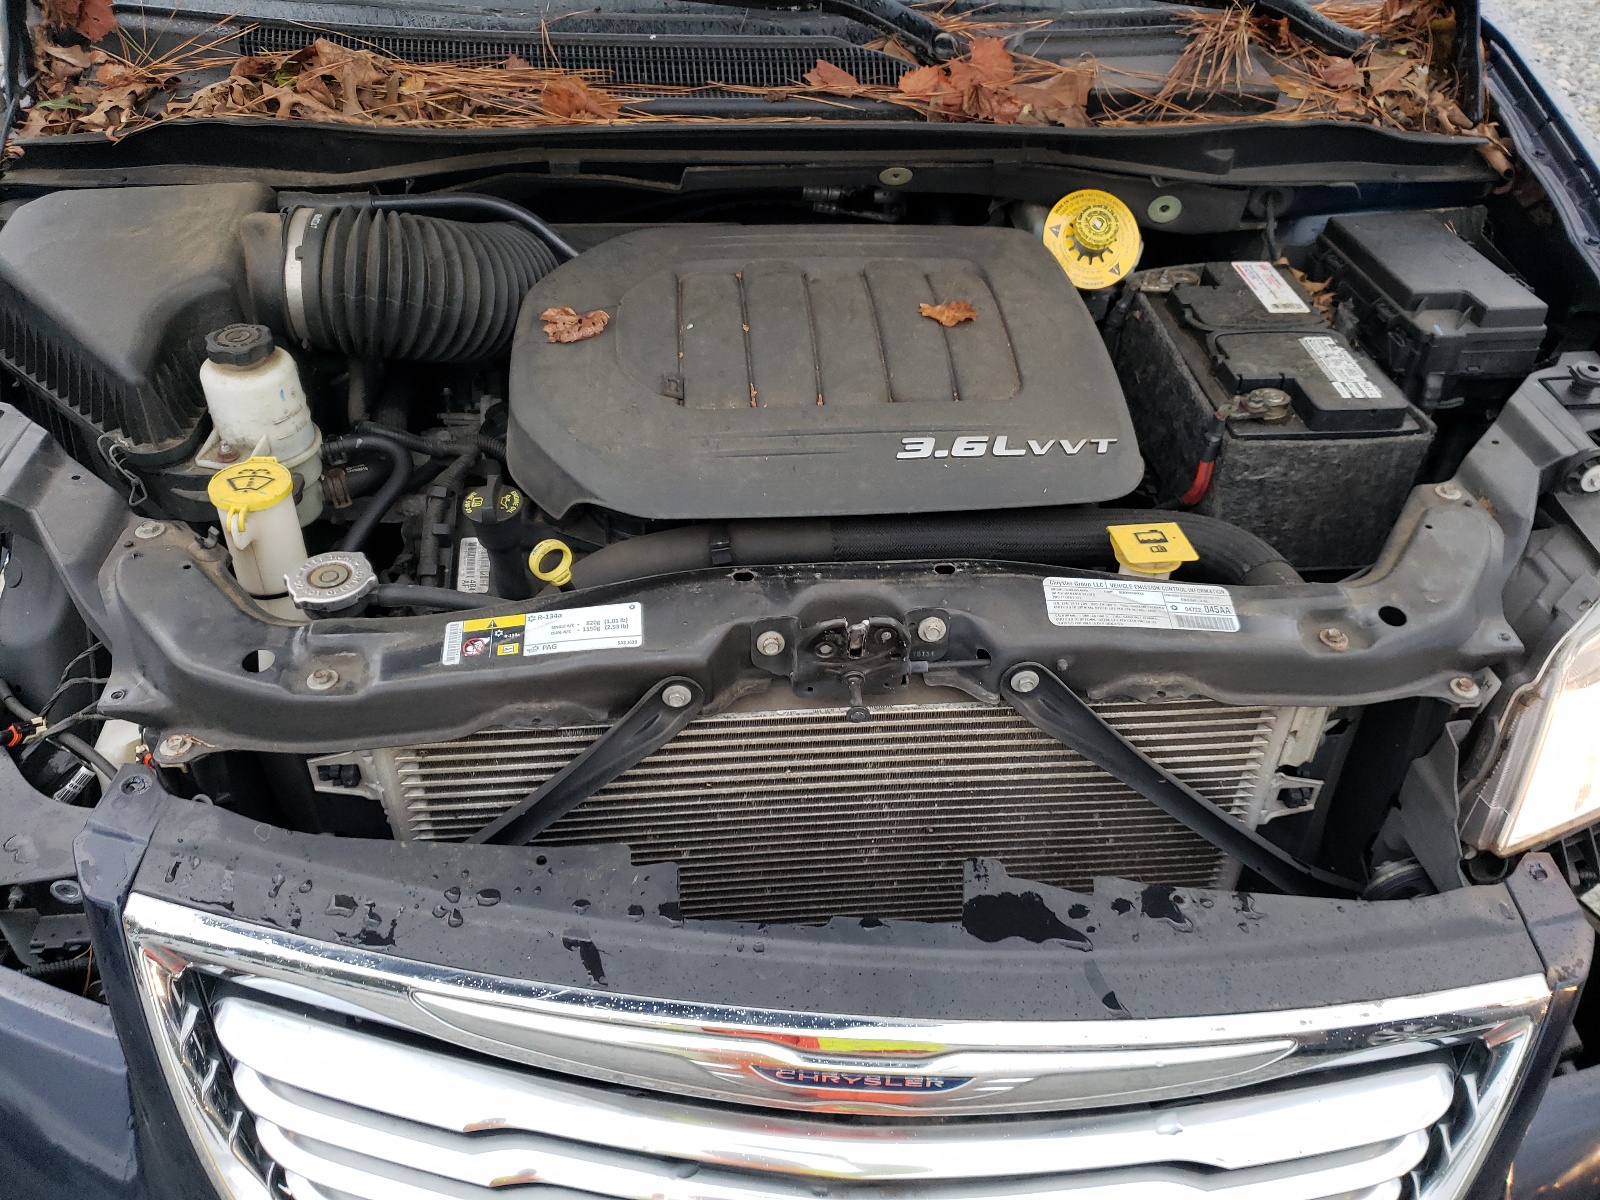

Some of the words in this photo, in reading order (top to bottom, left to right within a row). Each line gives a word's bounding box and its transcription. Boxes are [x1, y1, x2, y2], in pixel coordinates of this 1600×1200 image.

[1161, 585, 1187, 593] CONTROL
[1187, 587, 1225, 595] INFORMATION
[1203, 605, 1232, 615] 045AA
[537, 612, 563, 621] R-134a
[542, 643, 558, 651] PAG
[775, 1067, 945, 1089] CHRYSLER
